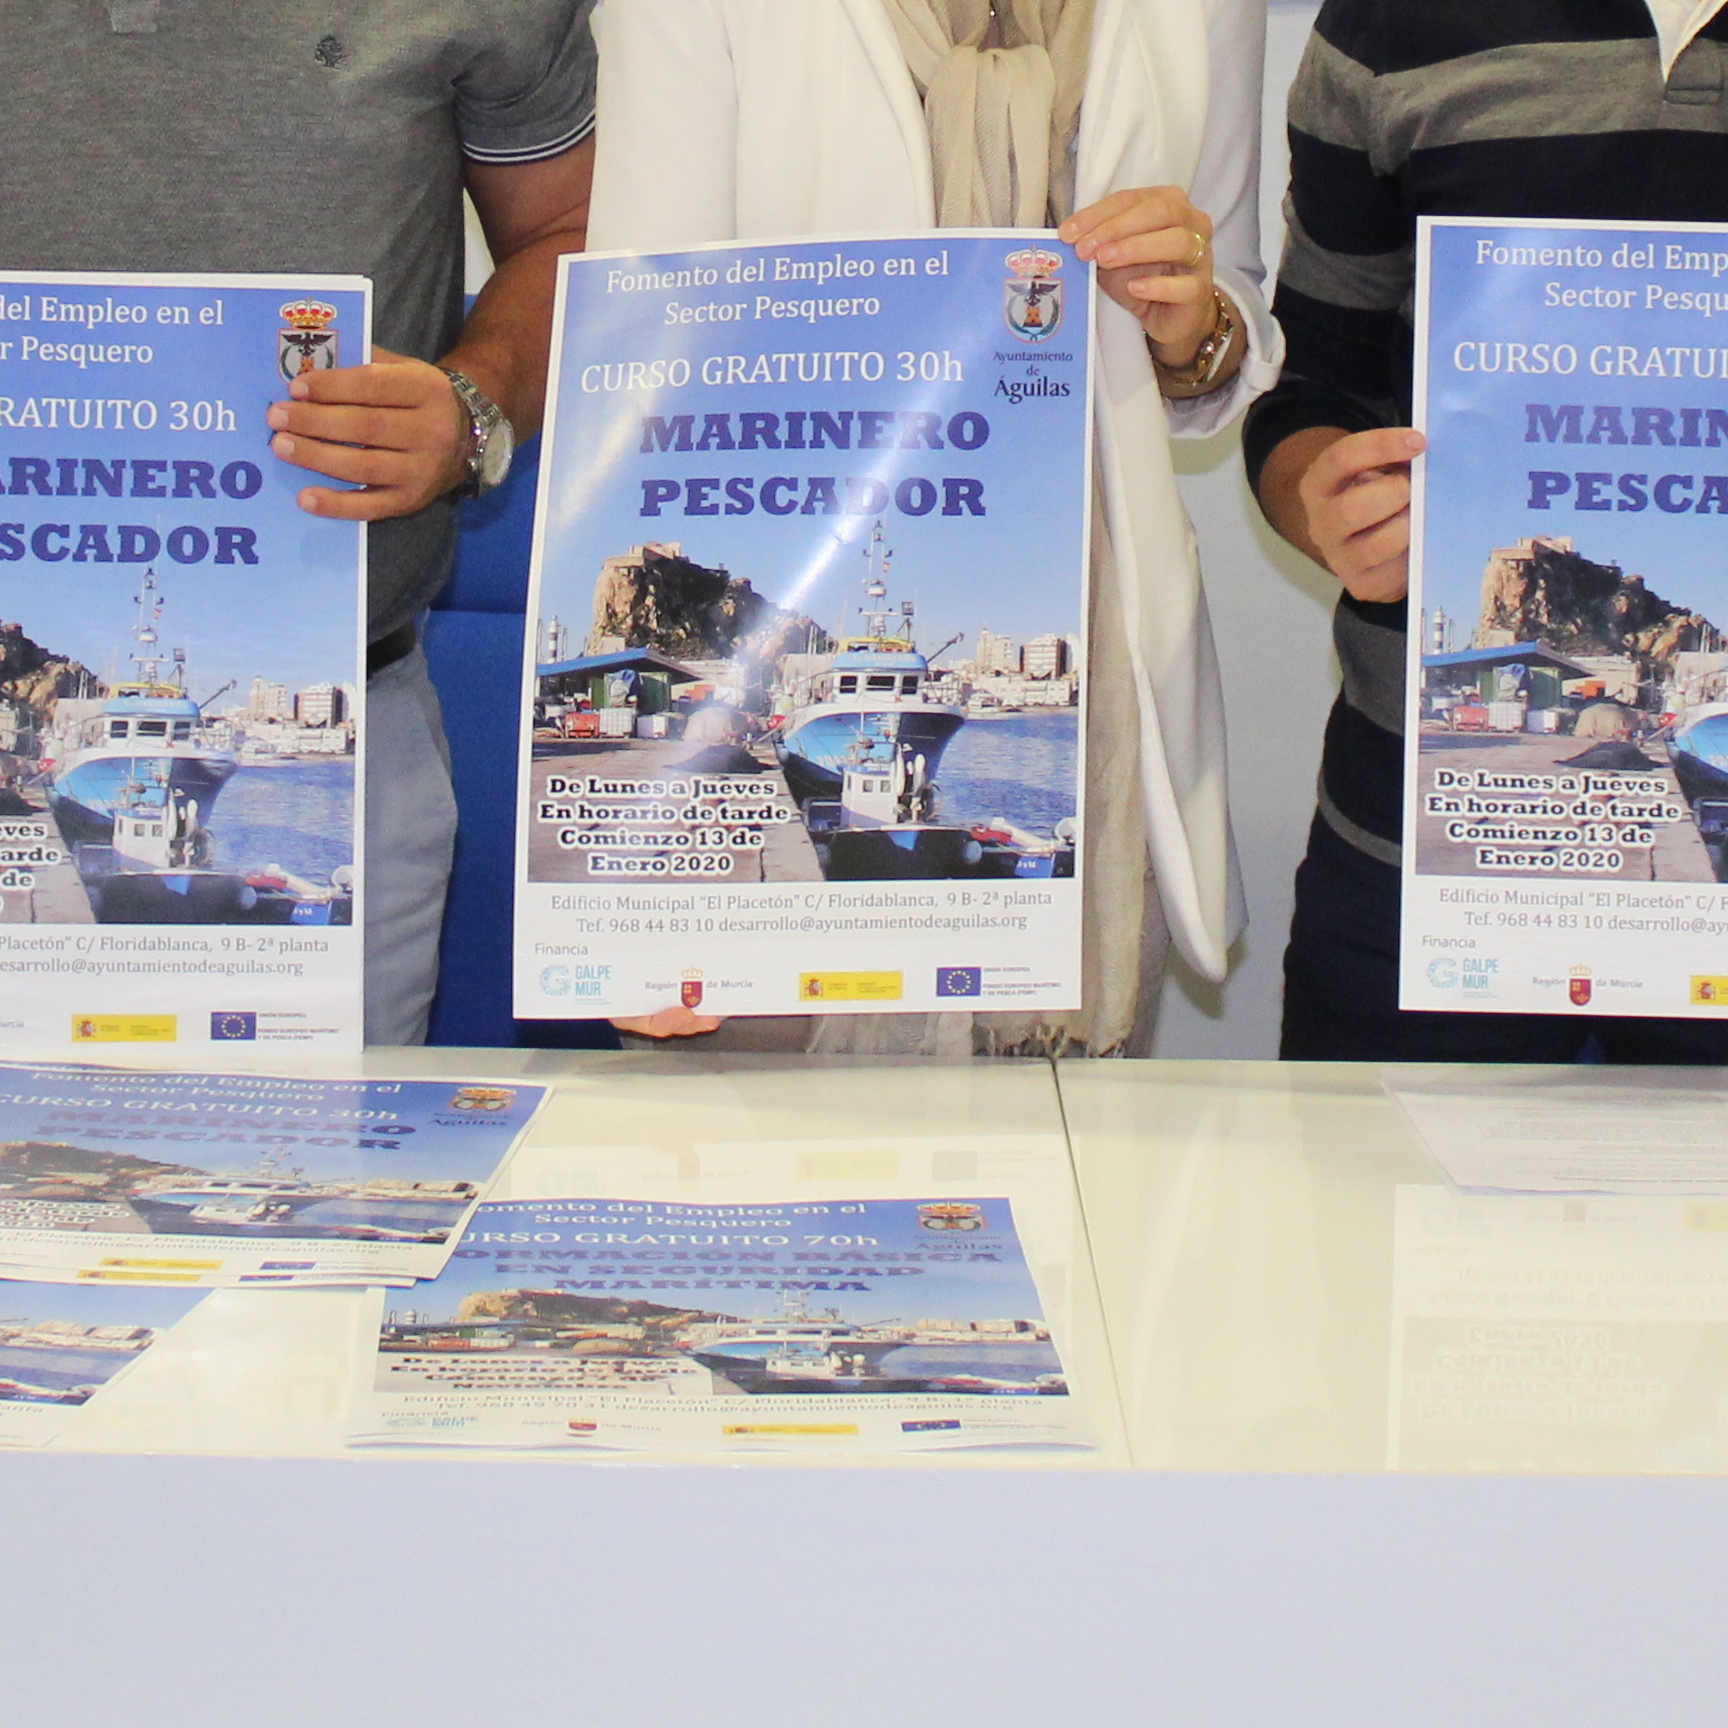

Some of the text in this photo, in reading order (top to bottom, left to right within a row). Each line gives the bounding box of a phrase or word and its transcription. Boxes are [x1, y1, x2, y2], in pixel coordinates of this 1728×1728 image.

[1476, 238, 1603, 268] Fomento
[1611, 243, 1655, 269] del
[605, 249, 948, 294] Fomento del Empleo en el
[1545, 282, 1637, 308] Sector
[40, 297, 148, 329] Empleo
[156, 305, 190, 325] en
[199, 299, 223, 325] el
[664, 295, 880, 326] Sector Pesquero
[21, 336, 153, 369] Pesquero
[993, 351, 1074, 365] Ayuntamiento
[1454, 342, 1578, 375] CURSO
[580, 350, 964, 395] CURSO GRATUITO 30h
[1026, 364, 1040, 376] de
[993, 375, 1071, 404] Águilas
[169, 400, 236, 431] 30h
[641, 410, 990, 453] MARINERO
[639, 476, 986, 517] PESCADOR
[2, 870, 33, 889] de
[551, 895, 611, 911] Edificio
[616, 895, 694, 914] Municipal
[804, 894, 823, 912] C/
[828, 892, 938, 909] Floridablanca,
[946, 892, 956, 906] 9
[961, 892, 977, 906] B-
[1003, 891, 1052, 910] planta
[609, 918, 640, 932] 968
[645, 918, 665, 932] 44
[670, 918, 690, 932] 83
[696, 917, 714, 932] 10
[534, 942, 589, 956] Financia
[575, 964, 612, 980] GALPE
[575, 981, 602, 996] MUR
[123, 1099, 319, 1117] GRATUITO
[333, 1107, 400, 1122] 30h
[533, 1212, 795, 1229] Sector Pesquero
[606, 1202, 867, 1218] del Empleo en el
[575, 1231, 880, 1248] GRATUITO 70h
